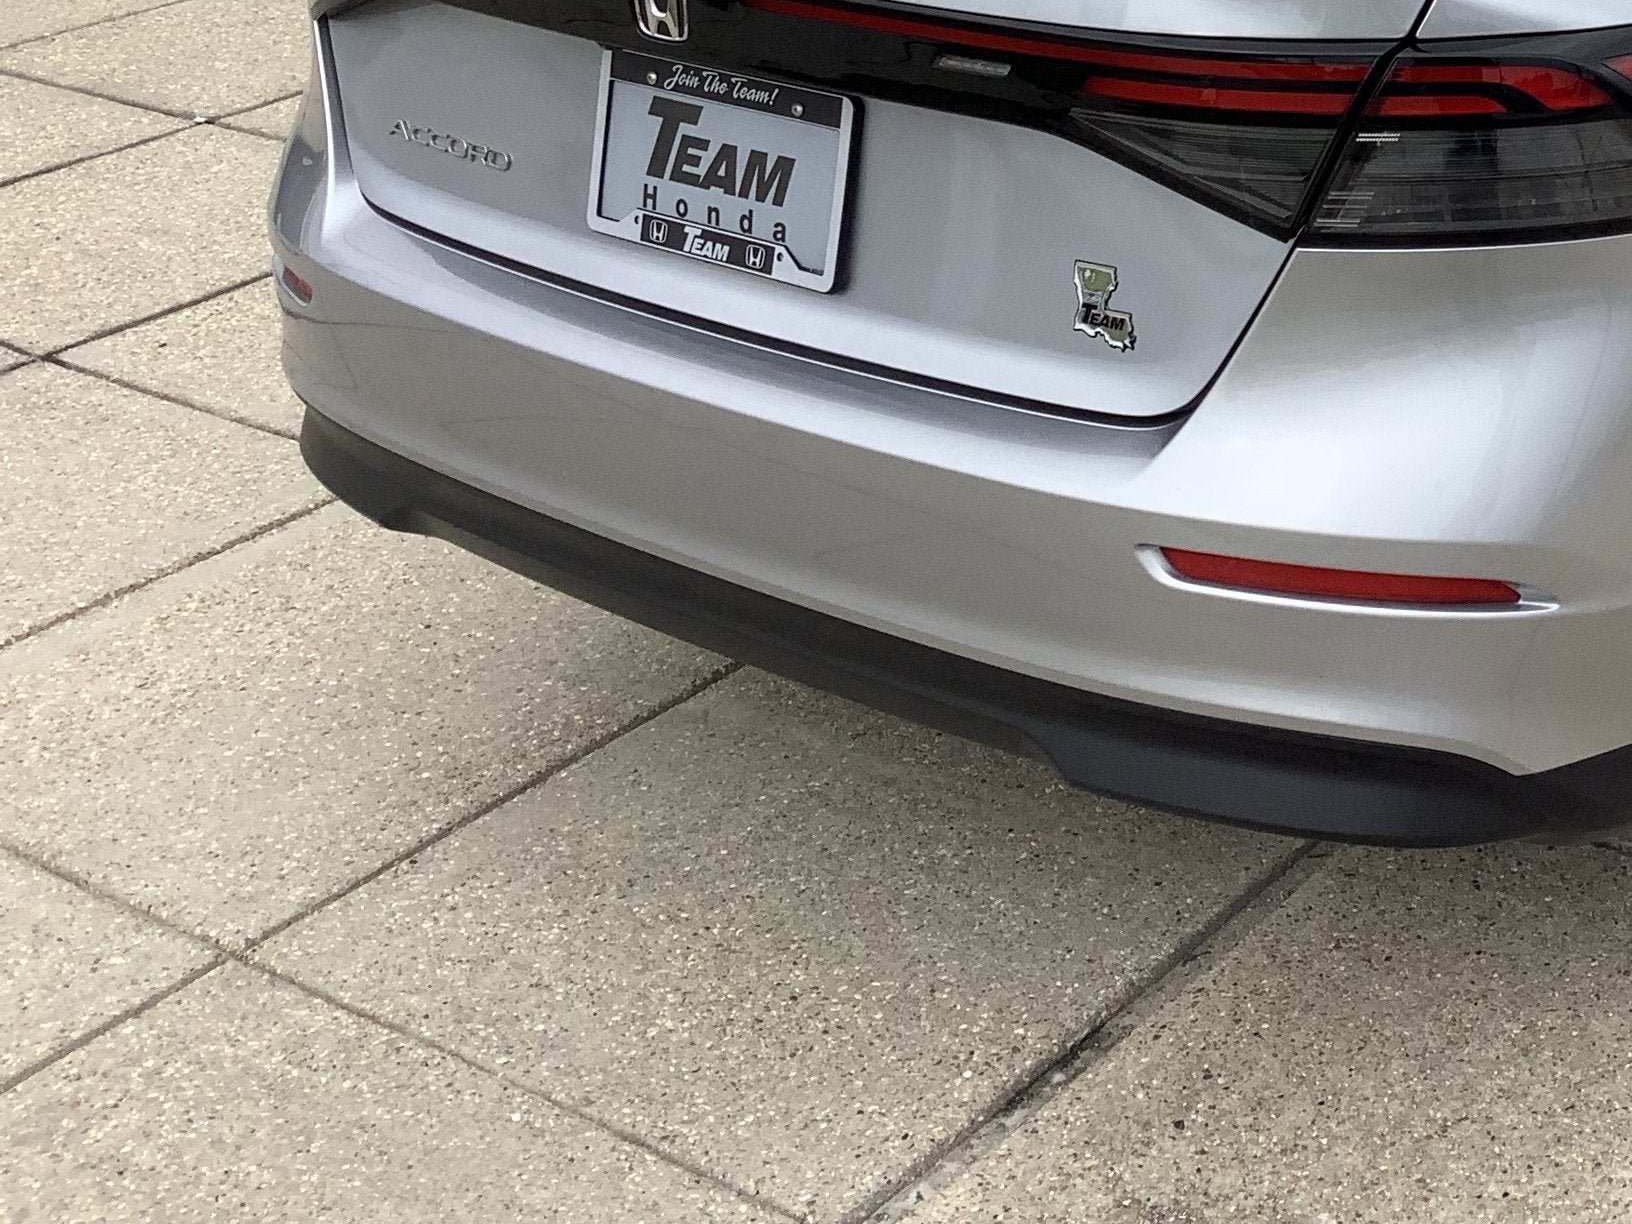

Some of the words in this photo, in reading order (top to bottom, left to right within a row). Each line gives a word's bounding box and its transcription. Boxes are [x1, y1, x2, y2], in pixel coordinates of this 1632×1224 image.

[663, 64, 700, 91] Join
[702, 70, 729, 95] The
[731, 77, 780, 106] Team!
[389, 119, 513, 172] ACCORD
[645, 95, 797, 208] TEAM
[642, 183, 788, 244] Honda
[683, 226, 731, 262] TEAM
[1081, 302, 1126, 330] TEAM
